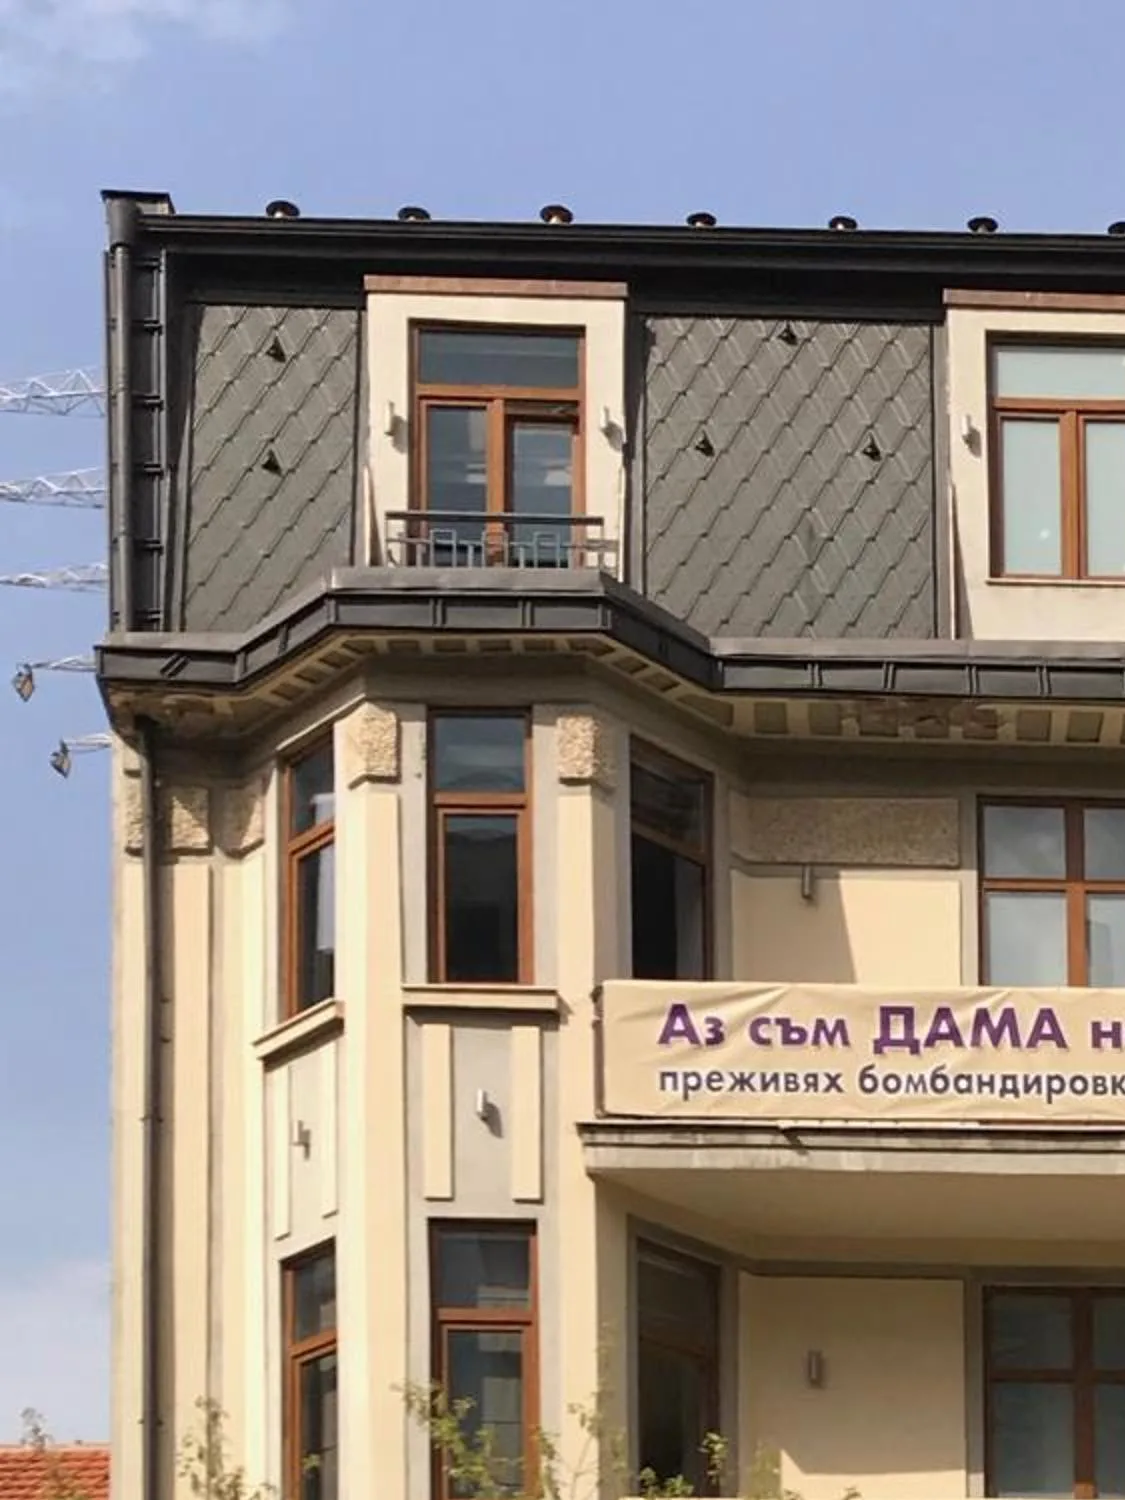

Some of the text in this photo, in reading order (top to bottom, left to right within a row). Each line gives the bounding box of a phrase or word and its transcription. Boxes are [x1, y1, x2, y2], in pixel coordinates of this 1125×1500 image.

[657, 1003, 725, 1046] Аз
[749, 1016, 850, 1047] съм
[873, 1006, 1068, 1055] ДАМА
[659, 1070, 844, 1100] преживях
